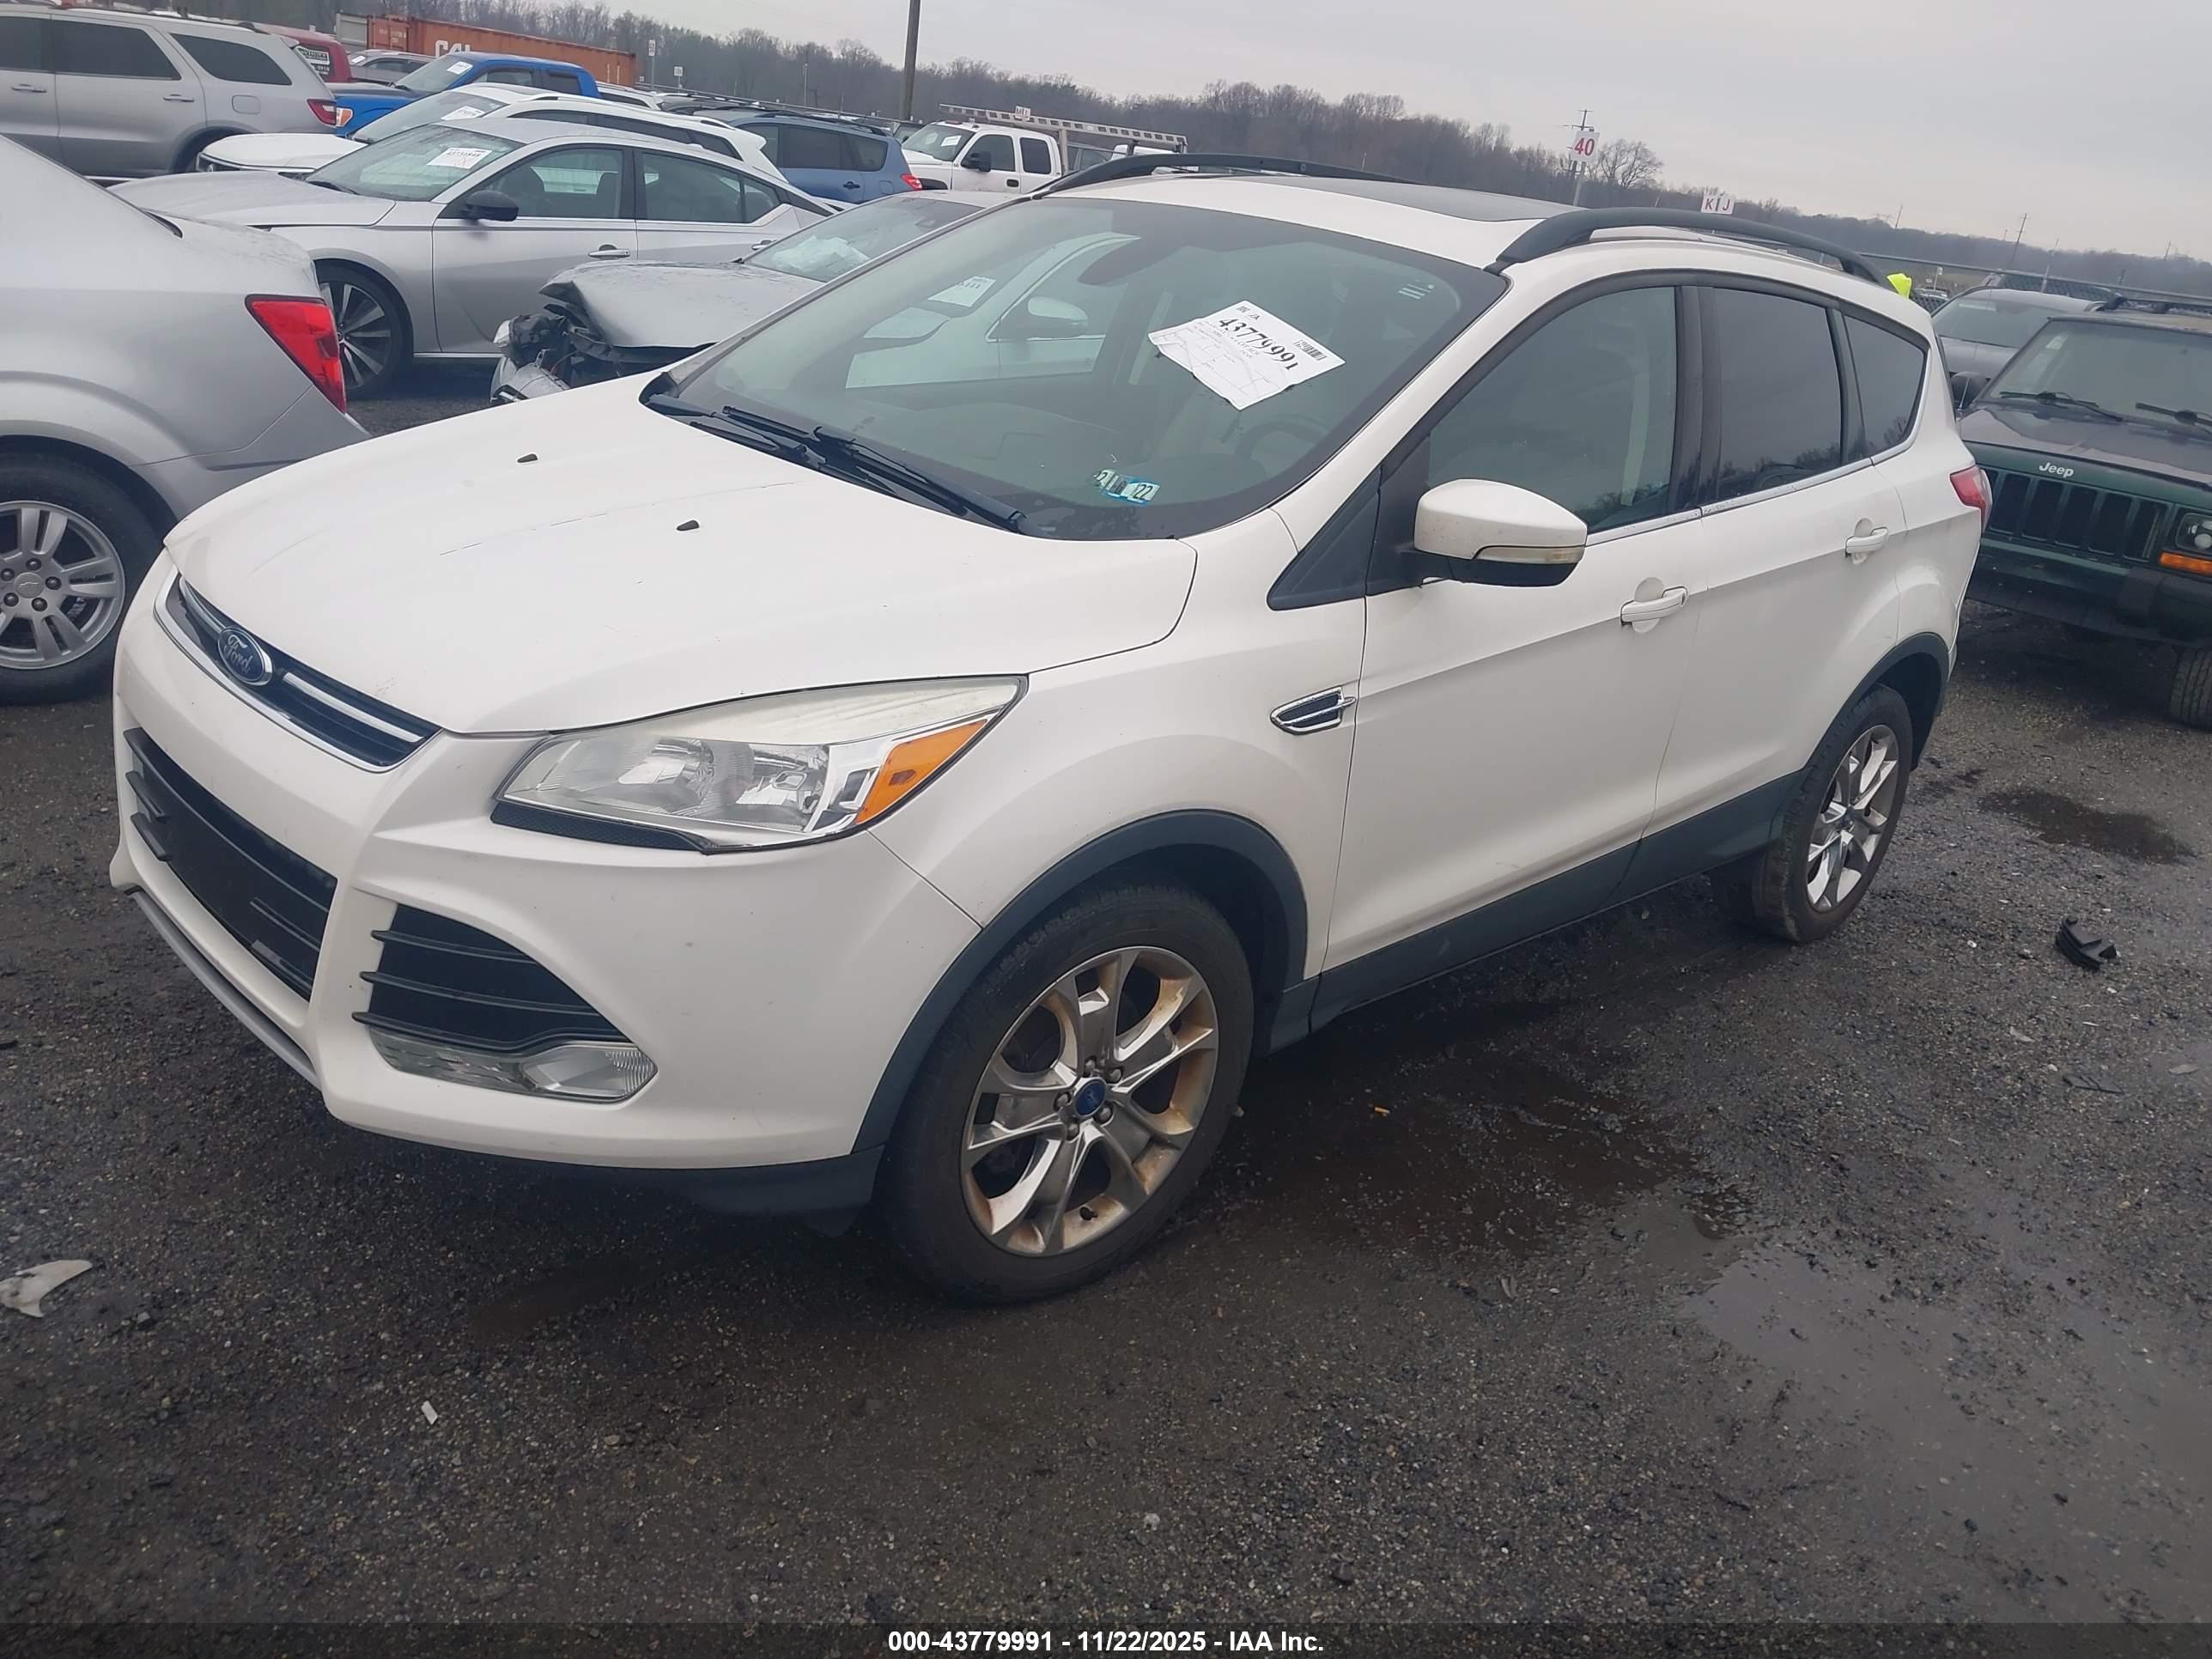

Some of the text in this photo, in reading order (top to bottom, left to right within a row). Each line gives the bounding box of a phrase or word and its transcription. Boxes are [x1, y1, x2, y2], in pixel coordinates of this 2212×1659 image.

[1574, 137, 1595, 156] 40
[1705, 198, 1731, 211] K J
[1218, 317, 1299, 371] 43779991
[2039, 462, 2075, 478] Jeep
[223, 634, 254, 674] Ford
